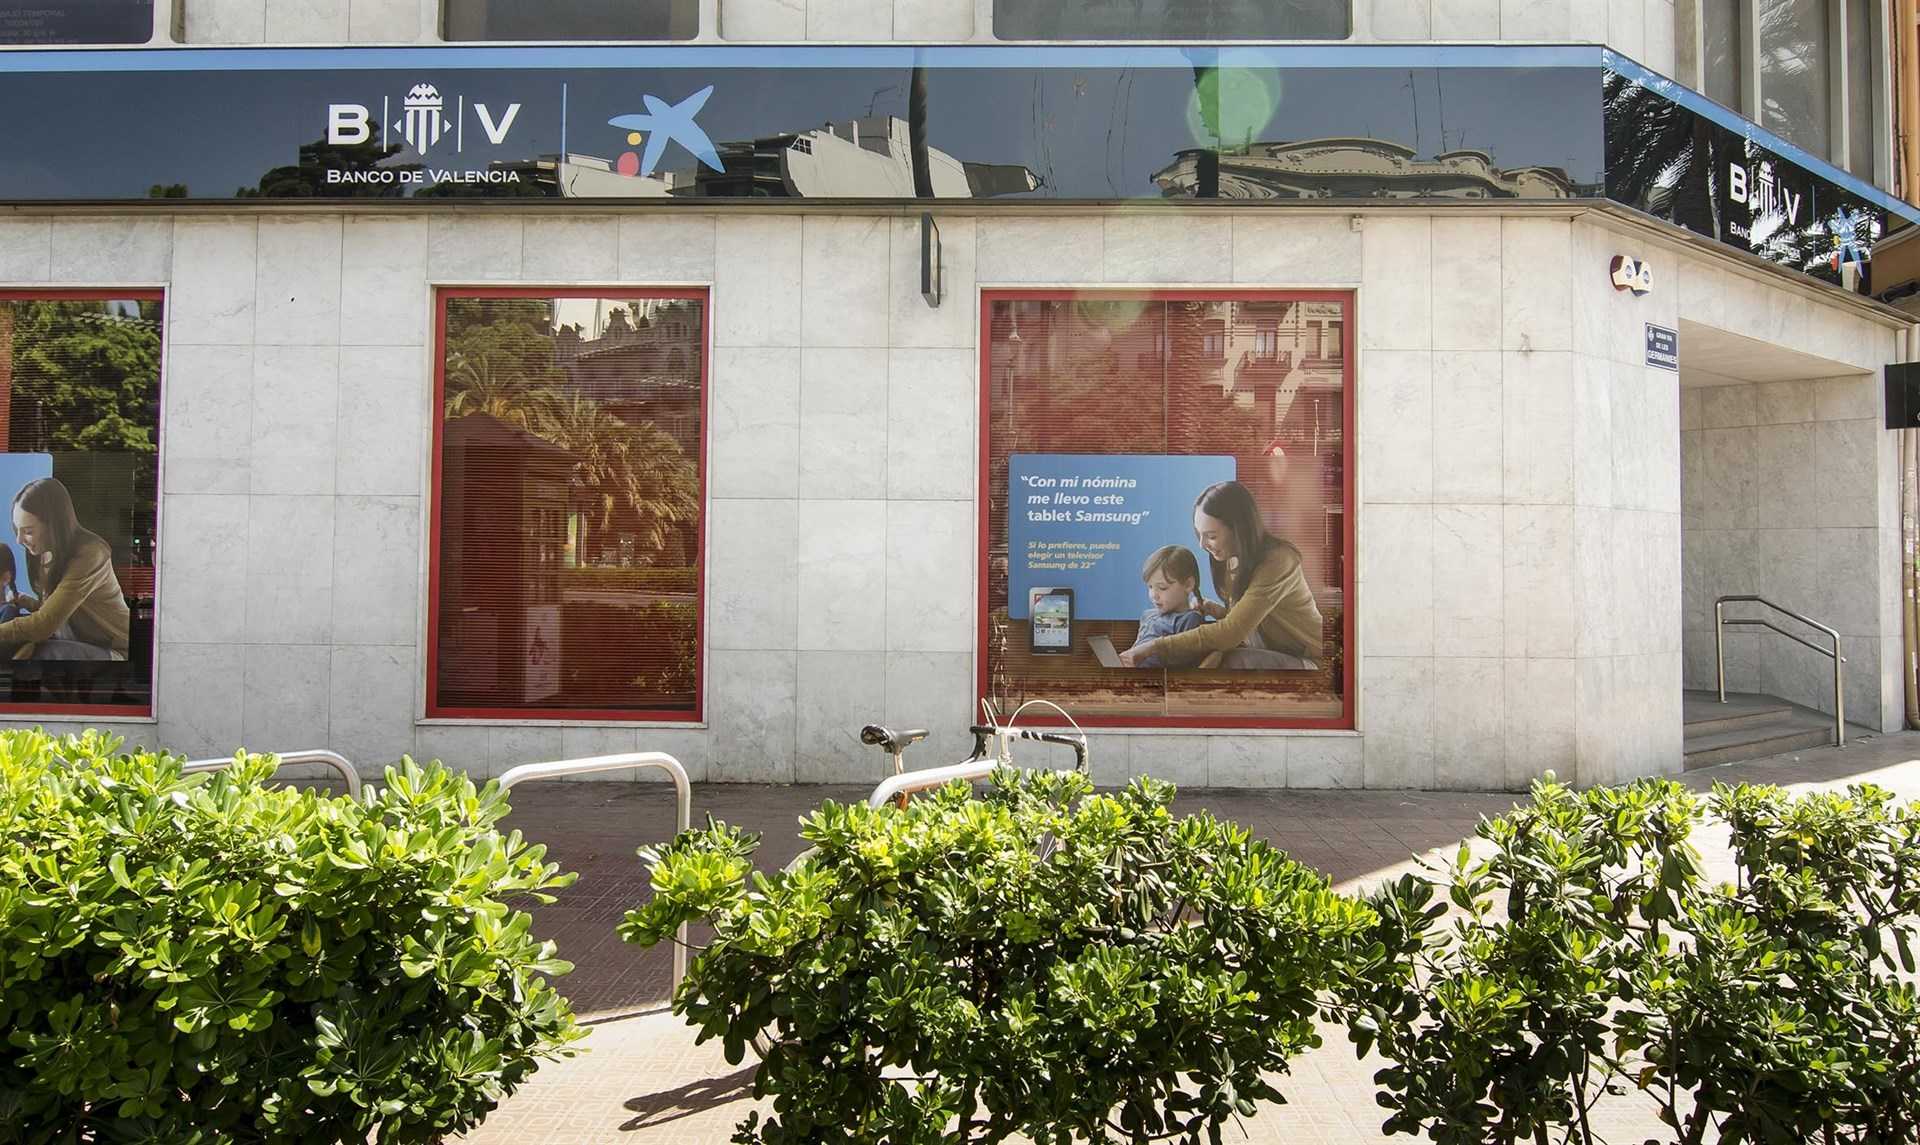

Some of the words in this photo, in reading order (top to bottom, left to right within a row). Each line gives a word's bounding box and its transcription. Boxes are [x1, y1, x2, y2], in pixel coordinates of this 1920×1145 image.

[328, 104, 370, 145] B
[473, 103, 521, 144] V
[327, 170, 394, 184] BANCO
[400, 171, 423, 183] DE
[428, 169, 520, 183] VALENCIA
[1730, 162, 1748, 204] B
[1783, 187, 1801, 226] V
[1060, 475, 1078, 488] mi
[1082, 475, 1137, 488] nómina
[1027, 495, 1050, 505] me
[1054, 492, 1089, 505] llevo
[1093, 494, 1124, 505] este
[1027, 510, 1072, 522] tablet
[1089, 541, 1121, 551] puedes
[1028, 552, 1053, 560] elegir
[1067, 551, 1104, 559] televisor
[1028, 561, 1066, 570] Samsung
[1067, 561, 1079, 569] de
